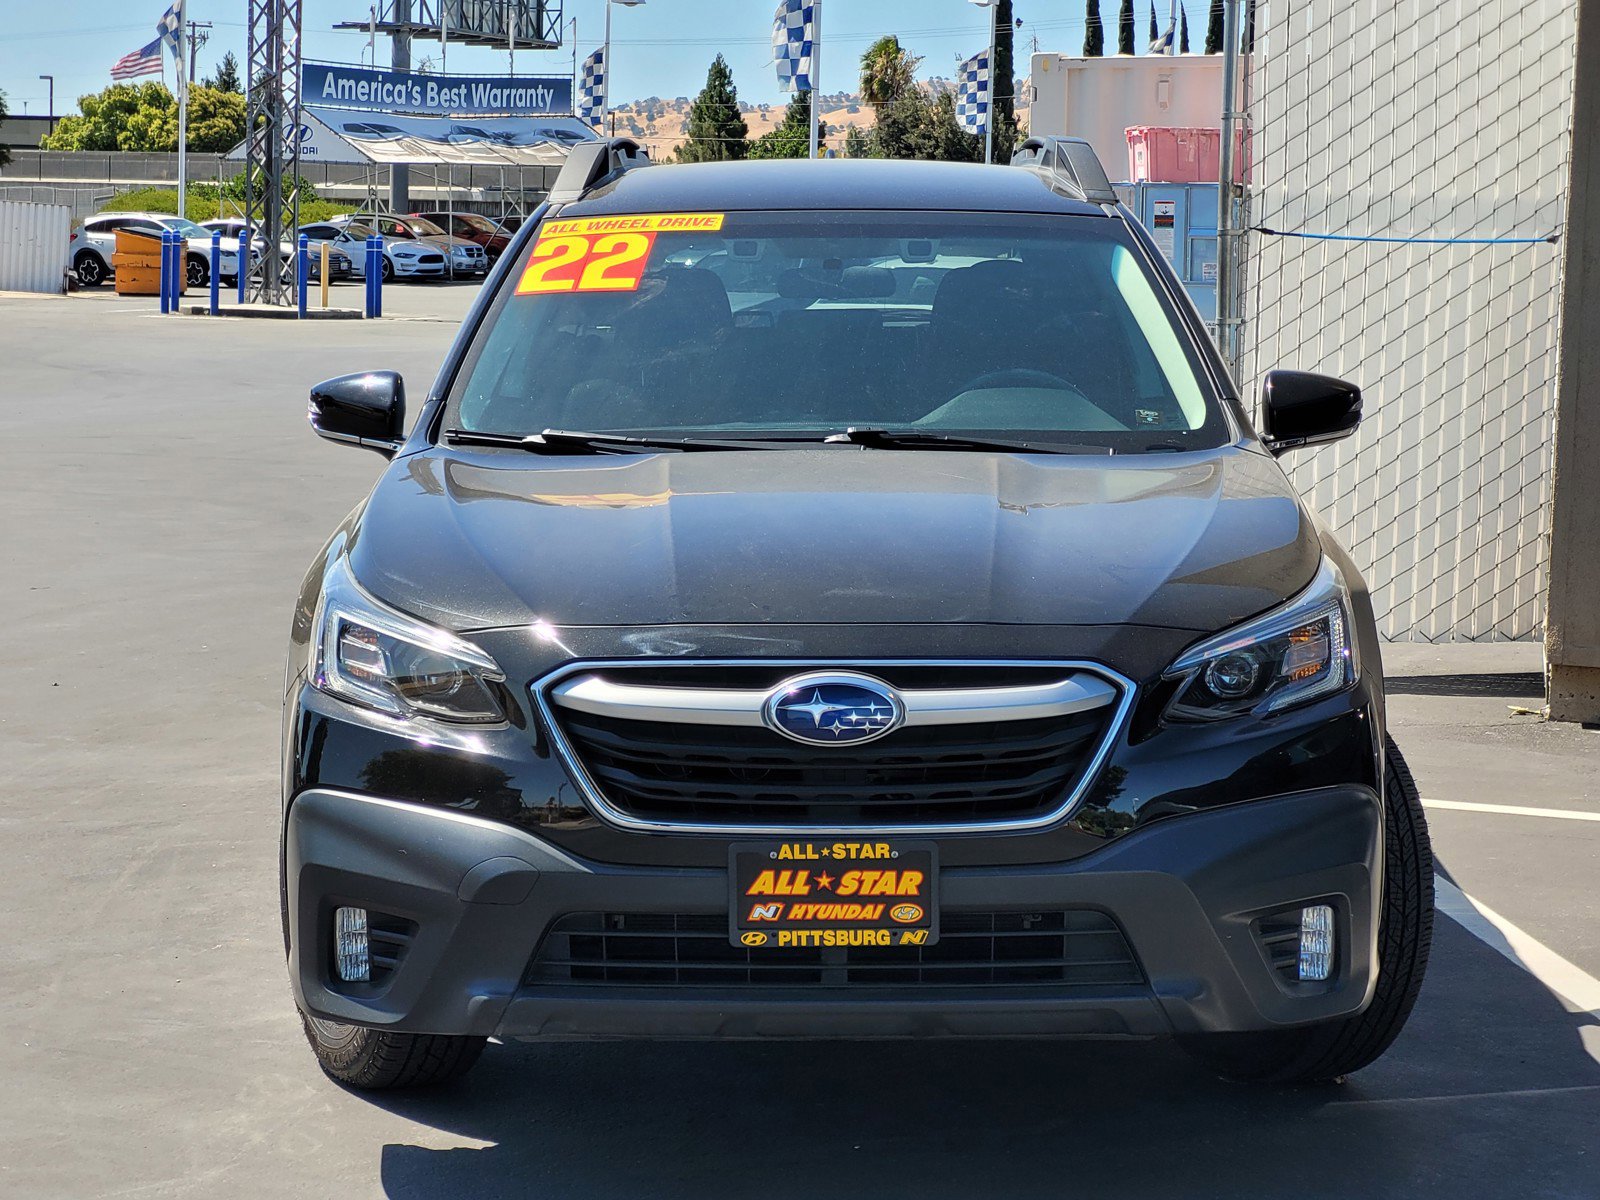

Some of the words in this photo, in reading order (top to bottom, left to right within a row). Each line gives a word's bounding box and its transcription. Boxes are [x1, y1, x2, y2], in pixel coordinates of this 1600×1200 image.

[322, 72, 422, 106] America's
[426, 81, 467, 108] Best
[471, 83, 554, 112] Warranty
[544, 219, 578, 235] ALL
[586, 217, 650, 231] WHEEL
[657, 216, 717, 227] DRIVE
[517, 233, 649, 293] 22
[777, 843, 819, 860] ALL
[832, 843, 890, 860] STAR
[745, 870, 812, 895] ALL
[835, 870, 923, 895] STAR
[786, 903, 886, 920] HYUNDAI
[778, 929, 891, 946] PITTSBURG
